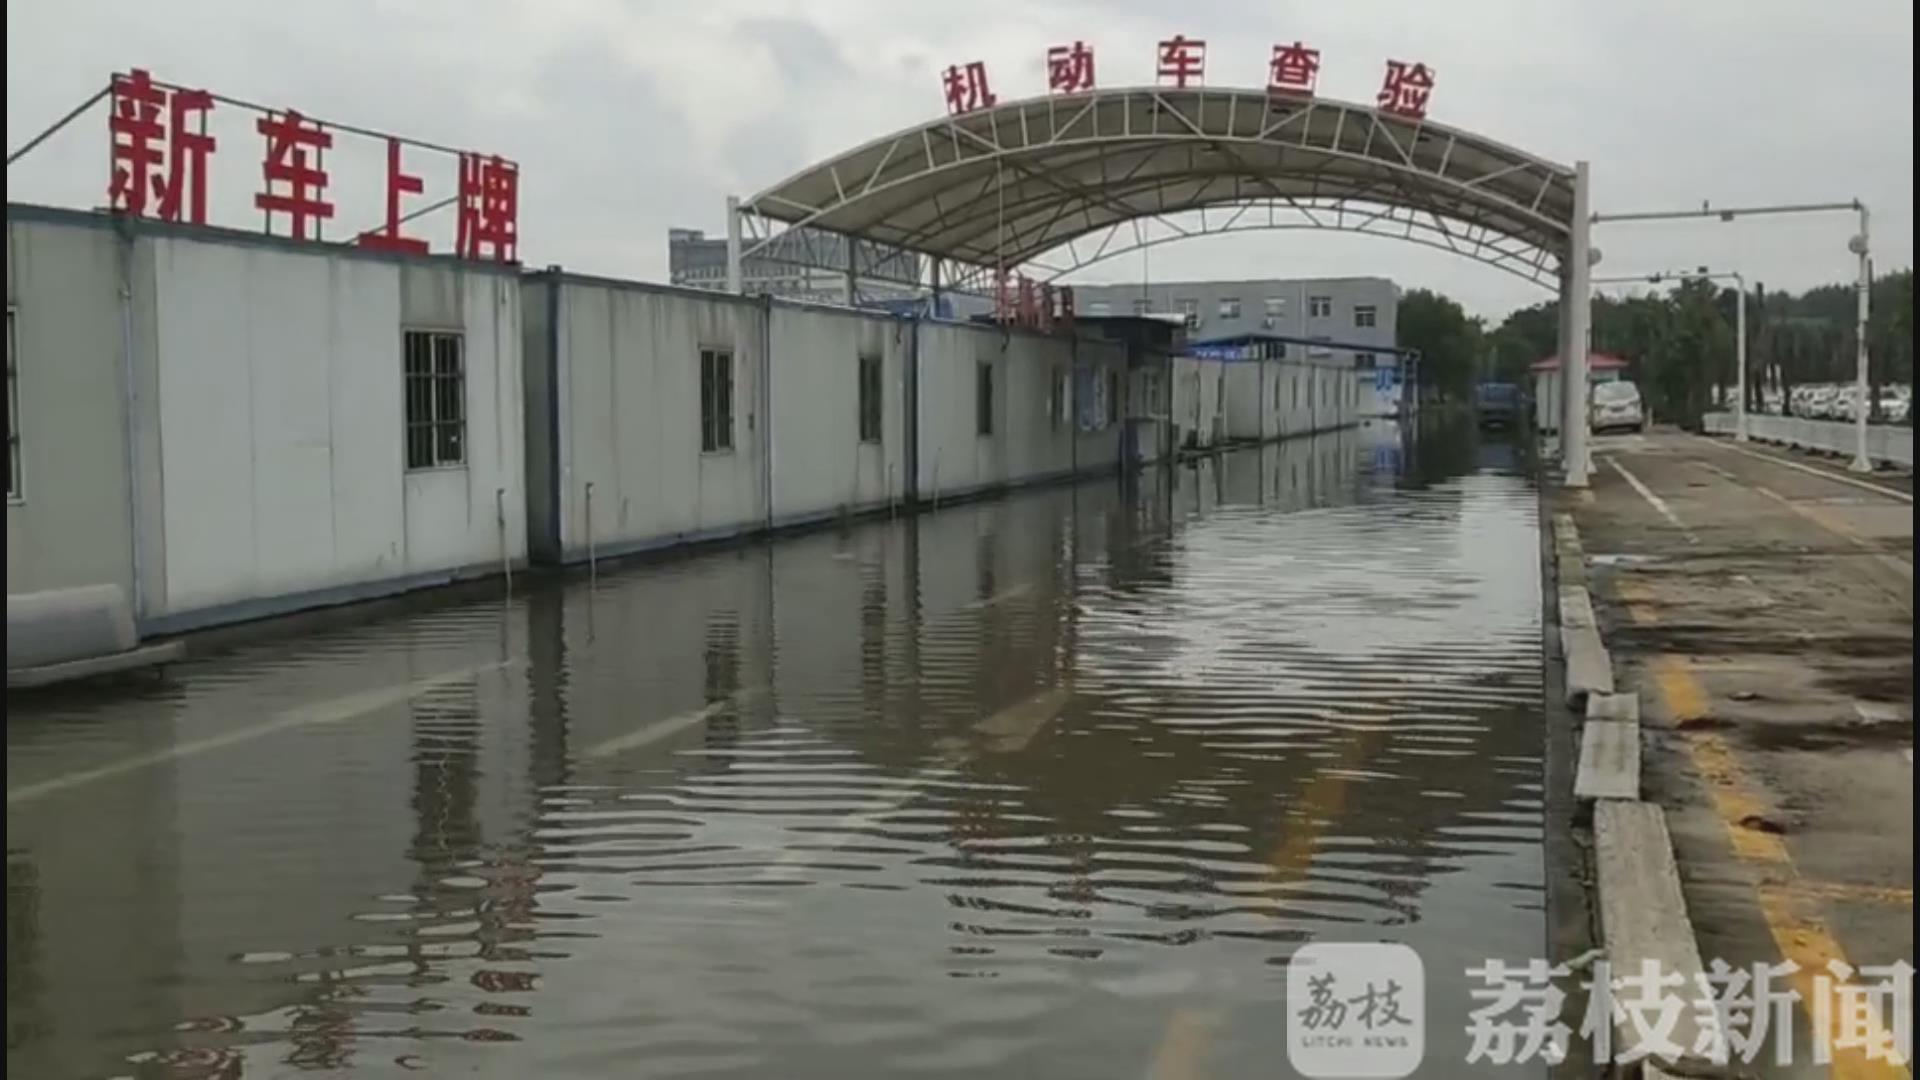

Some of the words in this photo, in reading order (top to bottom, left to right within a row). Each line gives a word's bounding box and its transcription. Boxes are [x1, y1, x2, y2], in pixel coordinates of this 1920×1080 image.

[942, 34, 1435, 119] 机动车查验
[108, 68, 518, 262] 新车上牌
